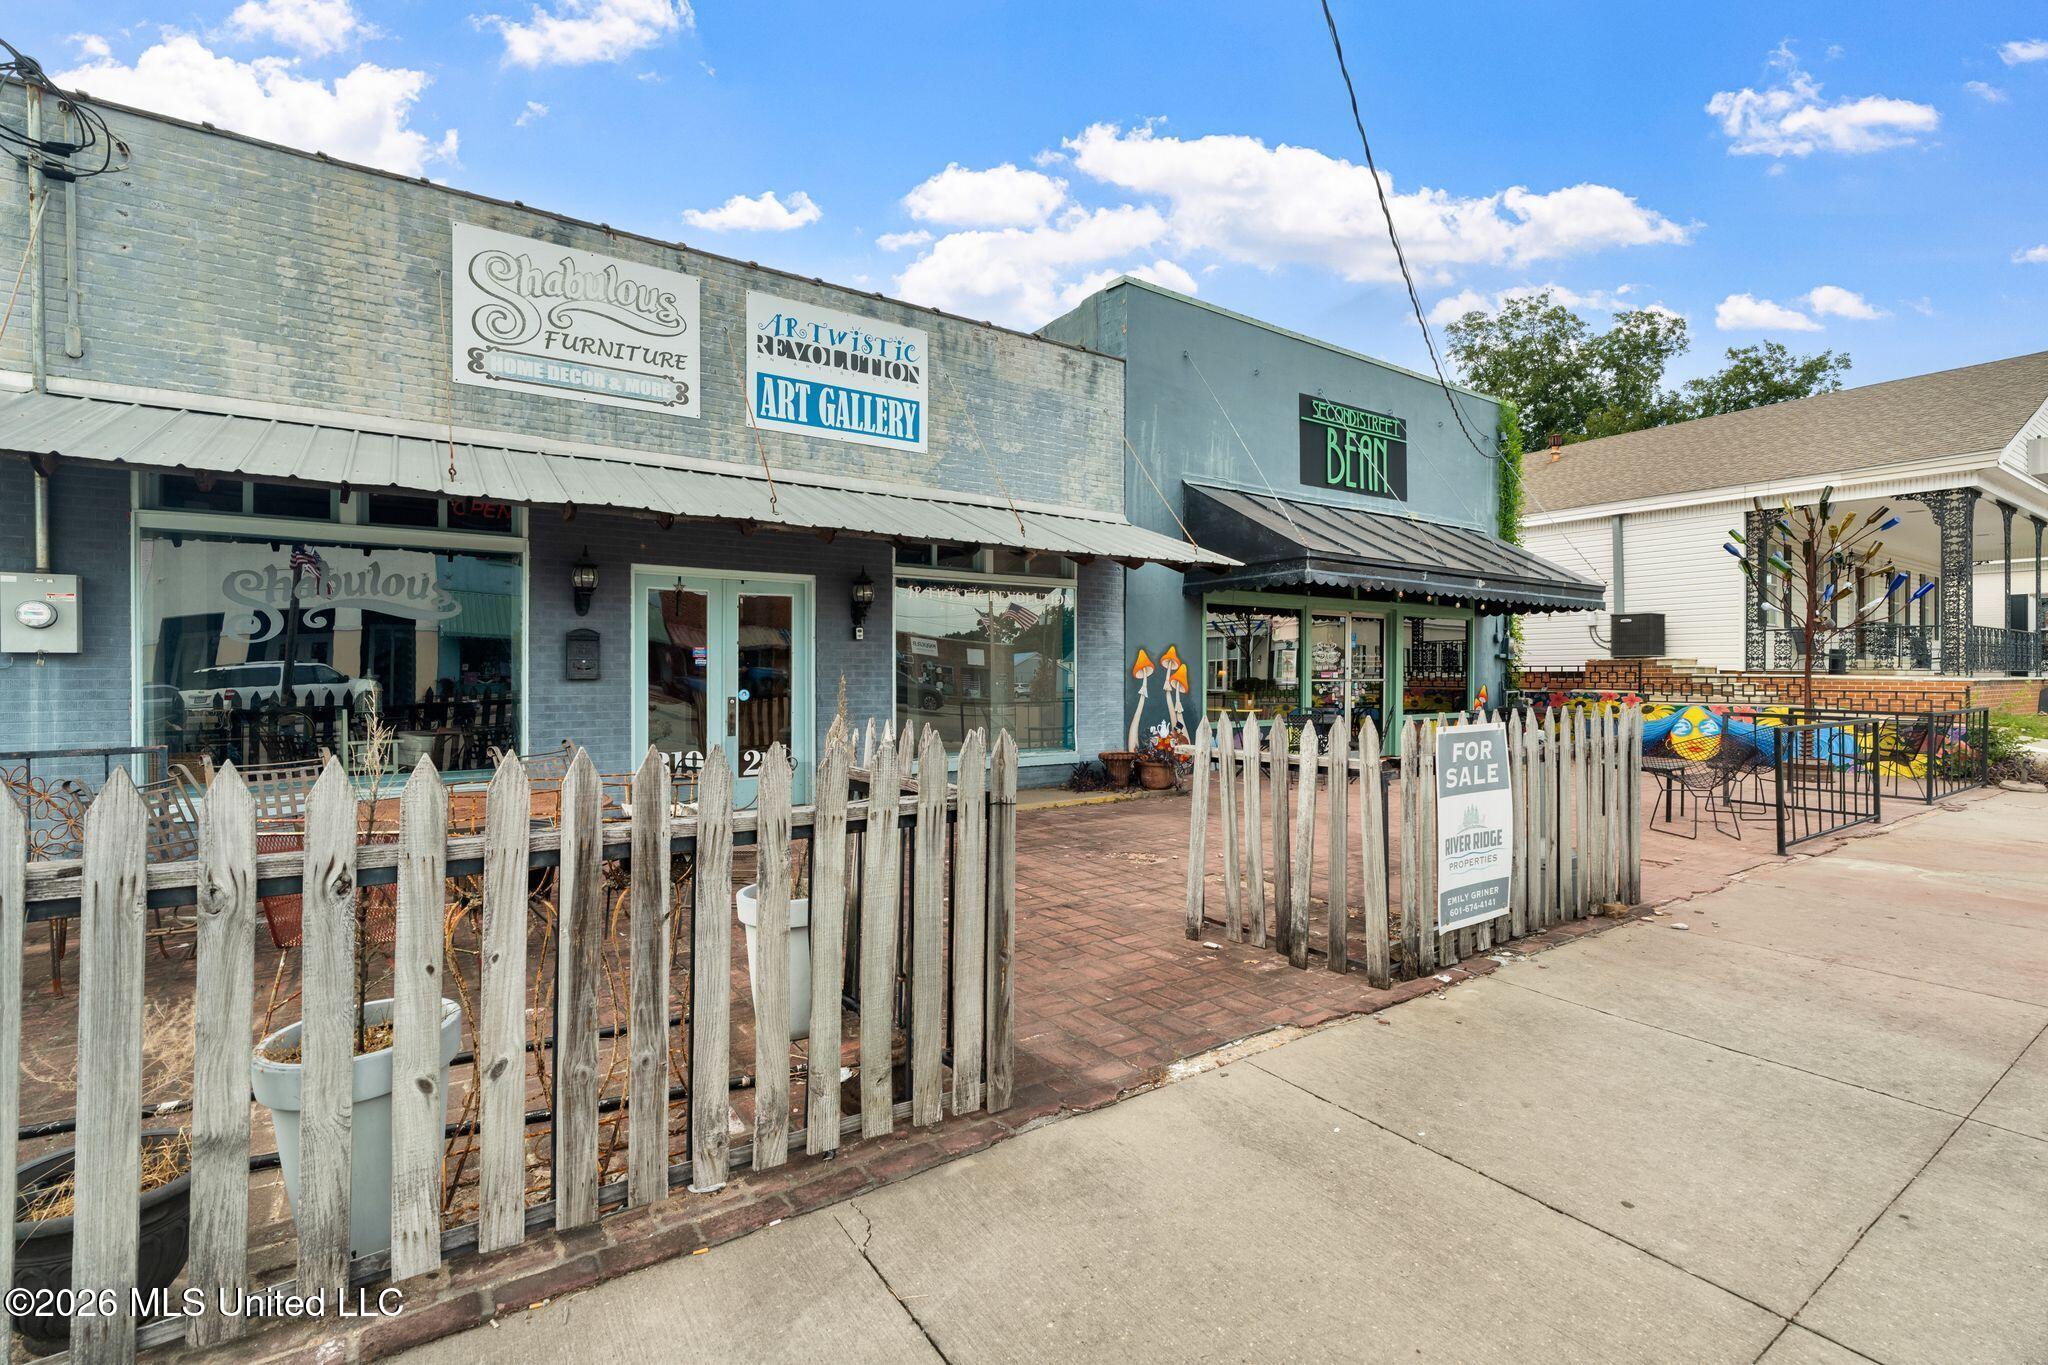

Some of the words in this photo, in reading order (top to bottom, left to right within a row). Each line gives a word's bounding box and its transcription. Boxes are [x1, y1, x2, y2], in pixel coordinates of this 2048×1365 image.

[468, 250, 687, 346] Shabulous
[544, 330, 689, 371] FURNITURE
[757, 334, 920, 385] REVOLUTION
[490, 355, 542, 379] HOME
[547, 364, 606, 387] DECOR
[608, 377, 622, 391] &
[625, 379, 673, 400] MORE
[760, 376, 811, 423] ART
[818, 387, 917, 440] GALLERY
[1326, 426, 1388, 493] BEAN
[222, 560, 463, 644] Shabulous
[1452, 740, 1493, 763] FOR
[1445, 763, 1499, 788] SALE
[1445, 834, 1471, 856] RIVER
[1473, 829, 1502, 849] RIDGE
[1449, 854, 1498, 871] PROPERTIES
[1447, 892, 1469, 906] EMILY
[1471, 886, 1499, 899] GRINER
